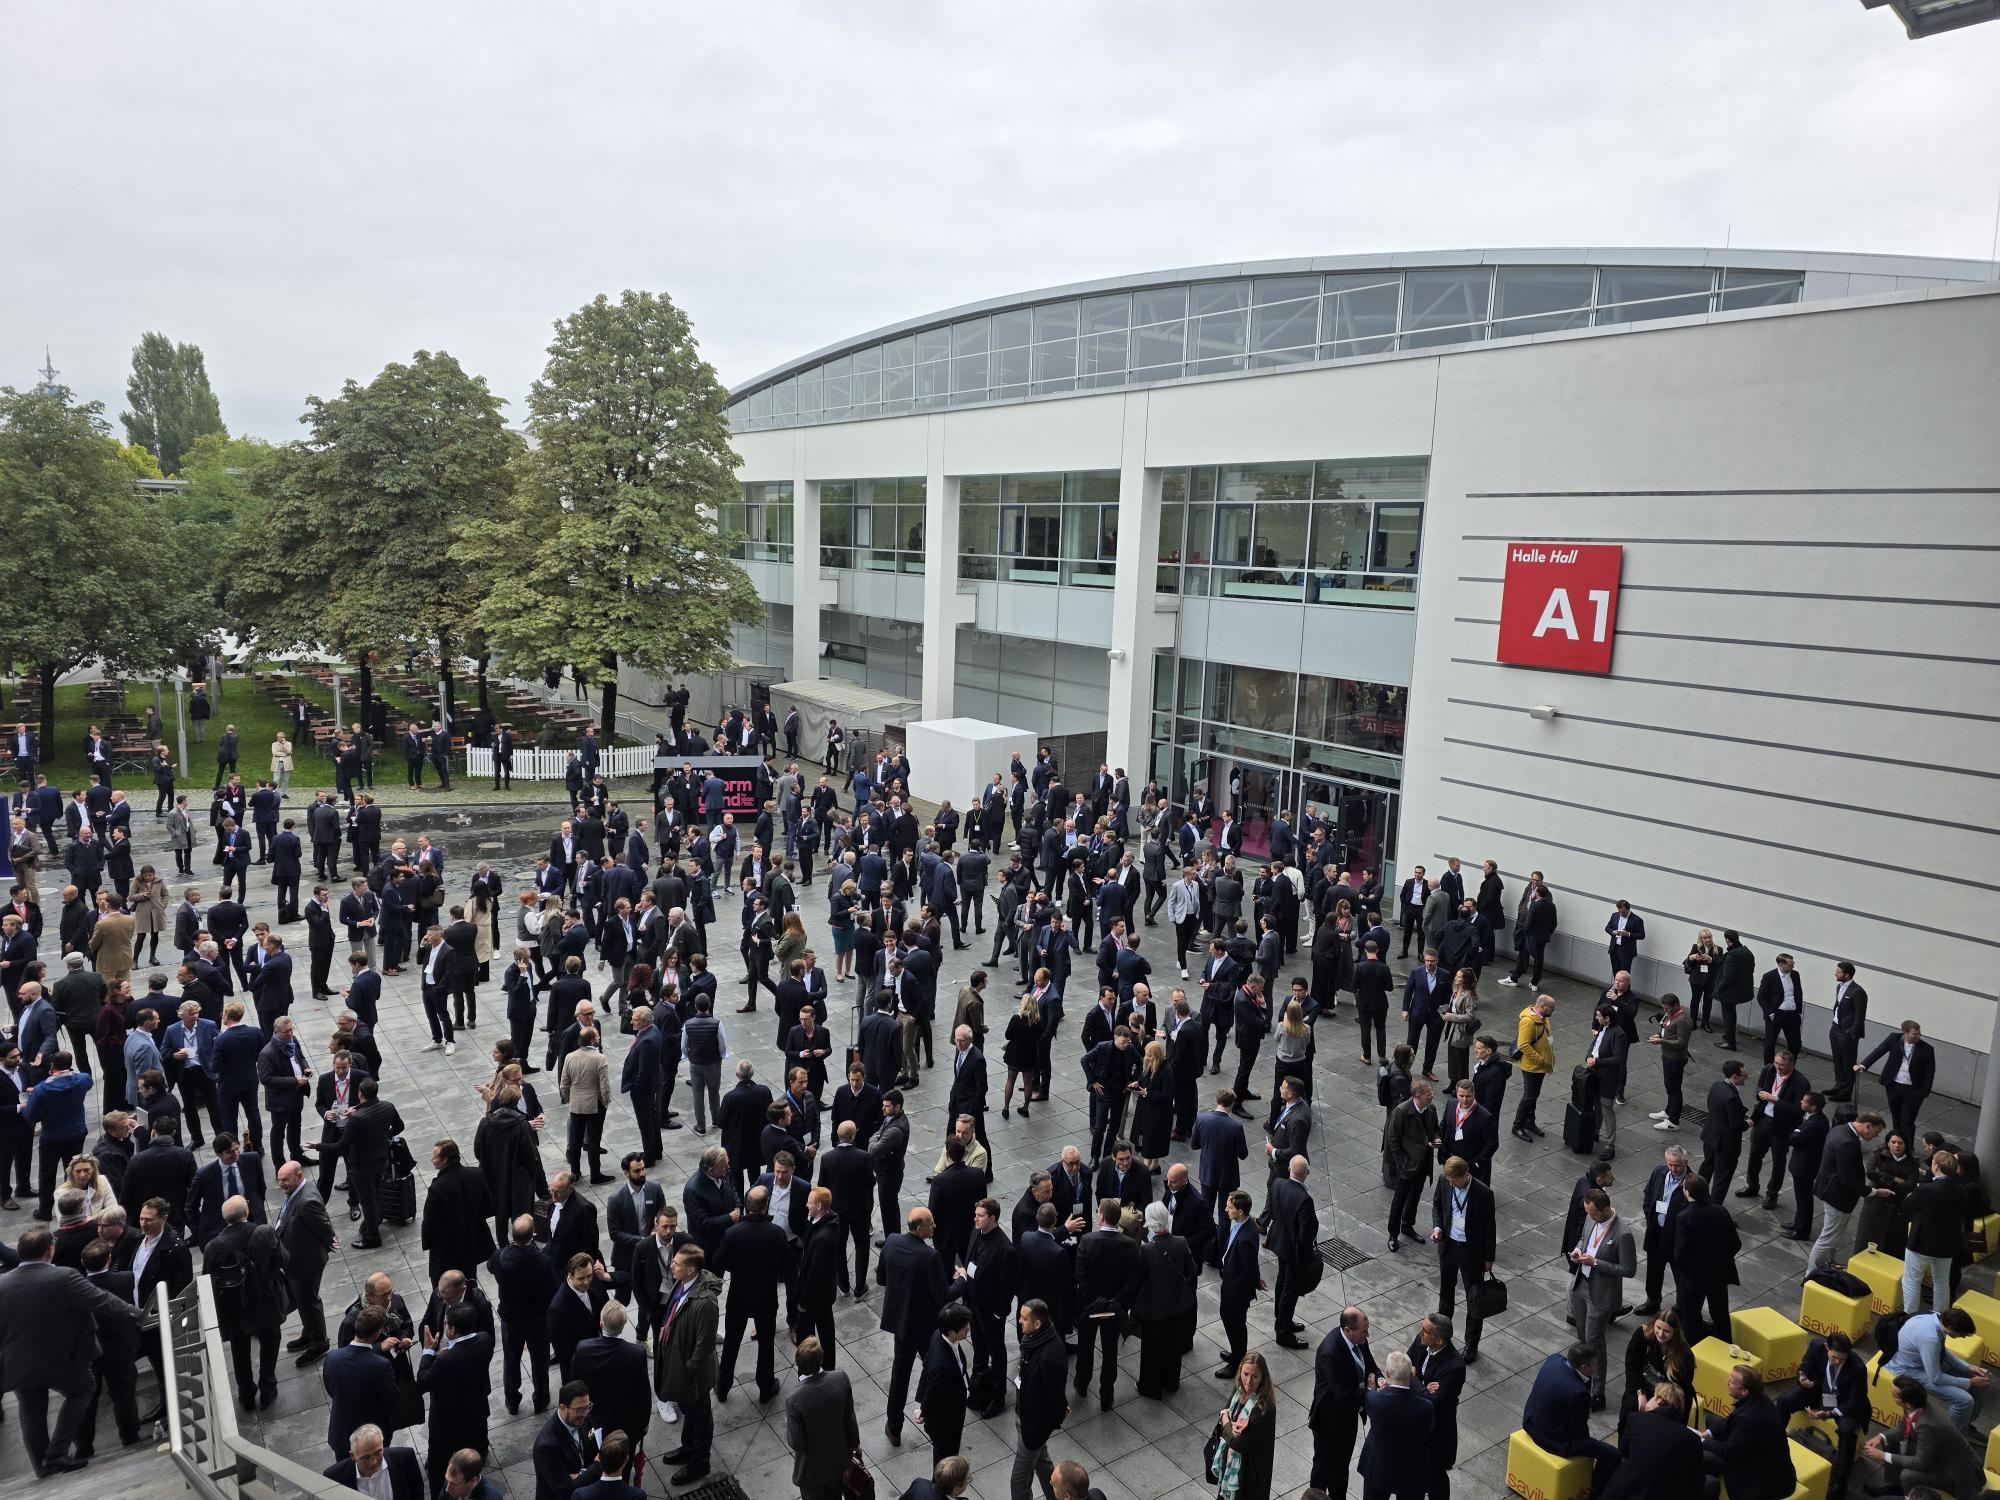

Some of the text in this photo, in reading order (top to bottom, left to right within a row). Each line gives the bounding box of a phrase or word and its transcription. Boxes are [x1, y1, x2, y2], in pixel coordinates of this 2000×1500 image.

[1512, 549, 1578, 564] Halle Hall
[1532, 587, 1610, 643] A1
[1366, 722, 1377, 732] A1
[1802, 1315, 1847, 1336] savill
[1507, 1473, 1549, 1500] savill
